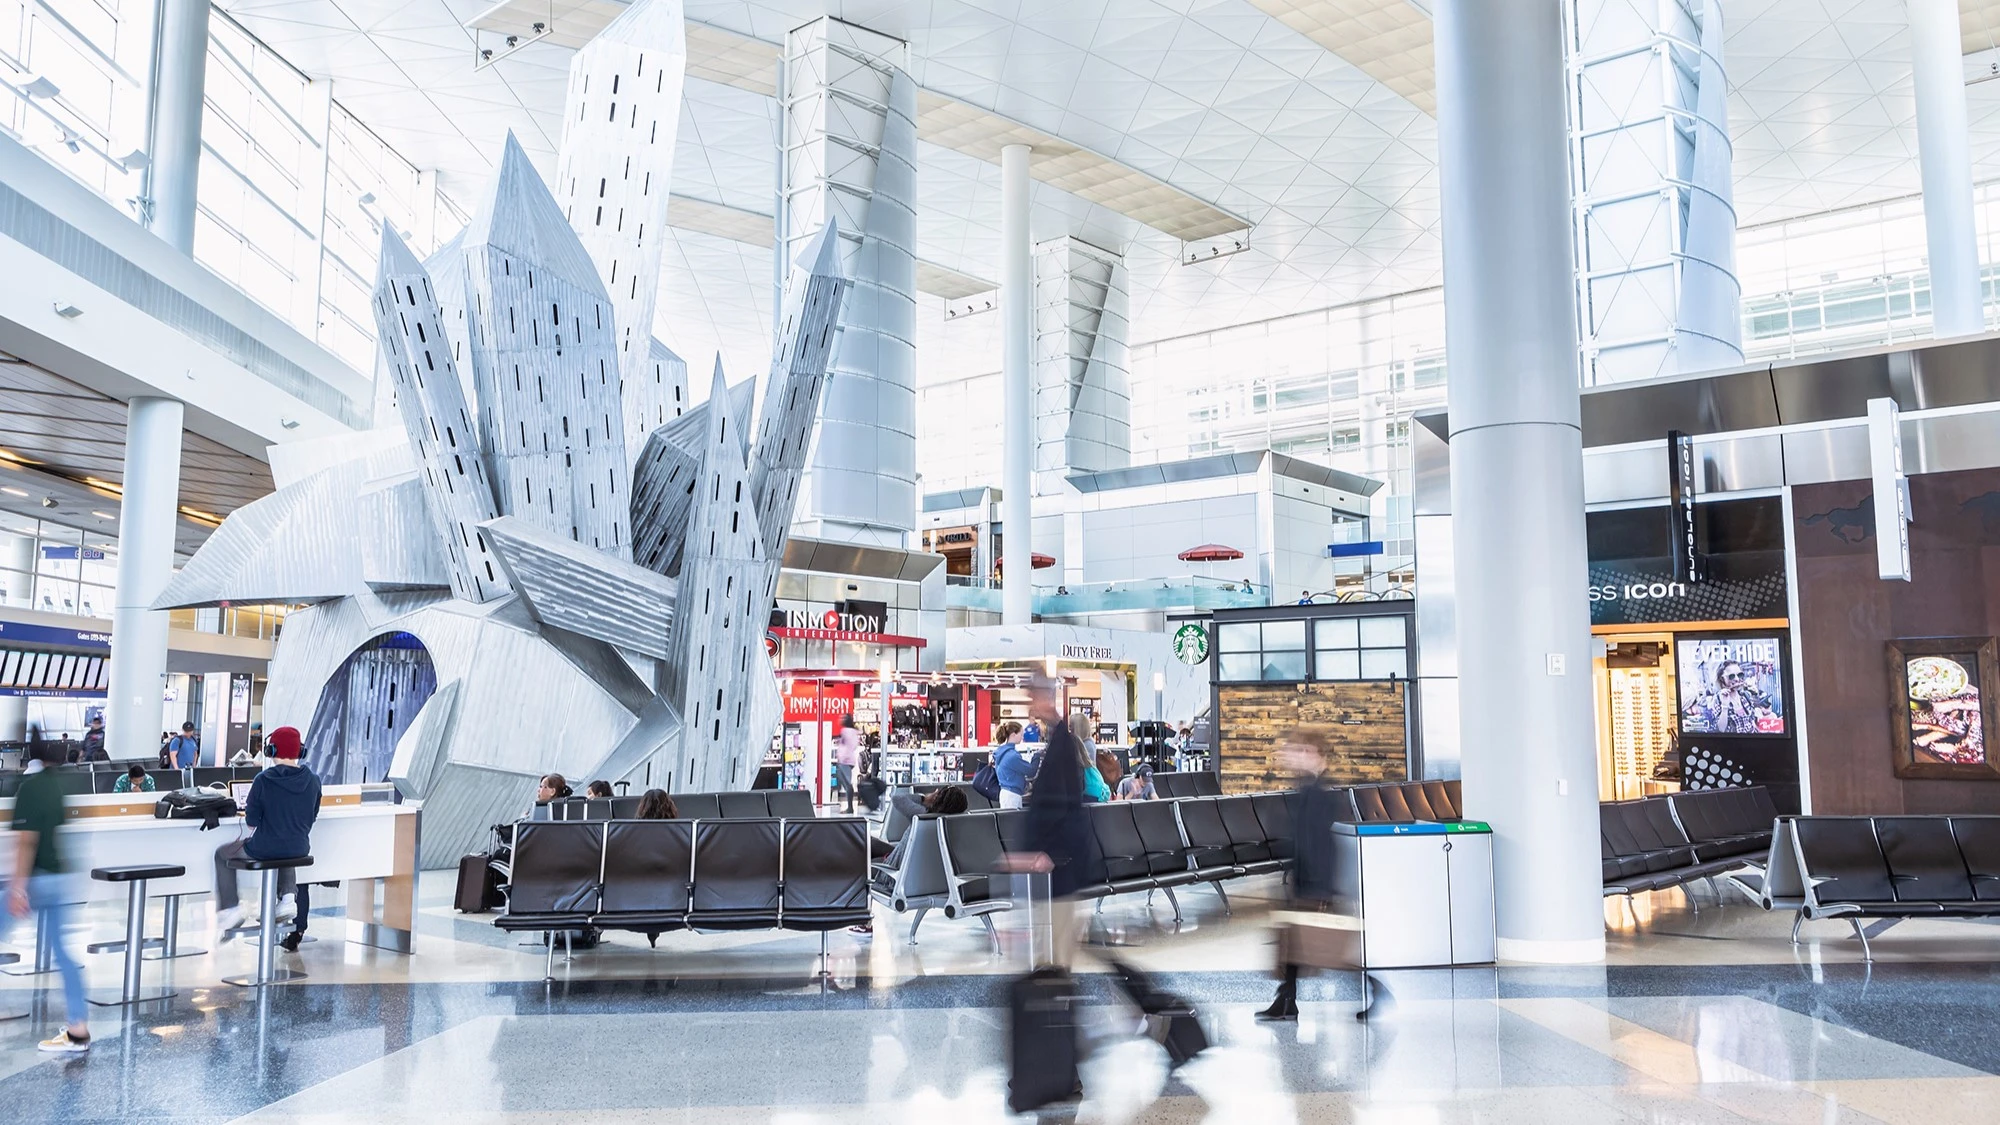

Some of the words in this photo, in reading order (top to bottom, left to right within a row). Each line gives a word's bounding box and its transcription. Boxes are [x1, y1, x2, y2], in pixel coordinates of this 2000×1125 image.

[786, 610, 879, 634] INMOTION
[786, 629, 878, 642] ENTERTAINMENT
[1062, 644, 1087, 657] DUTY
[1090, 645, 1112, 659] FREE
[1736, 643, 1775, 662] HIDE
